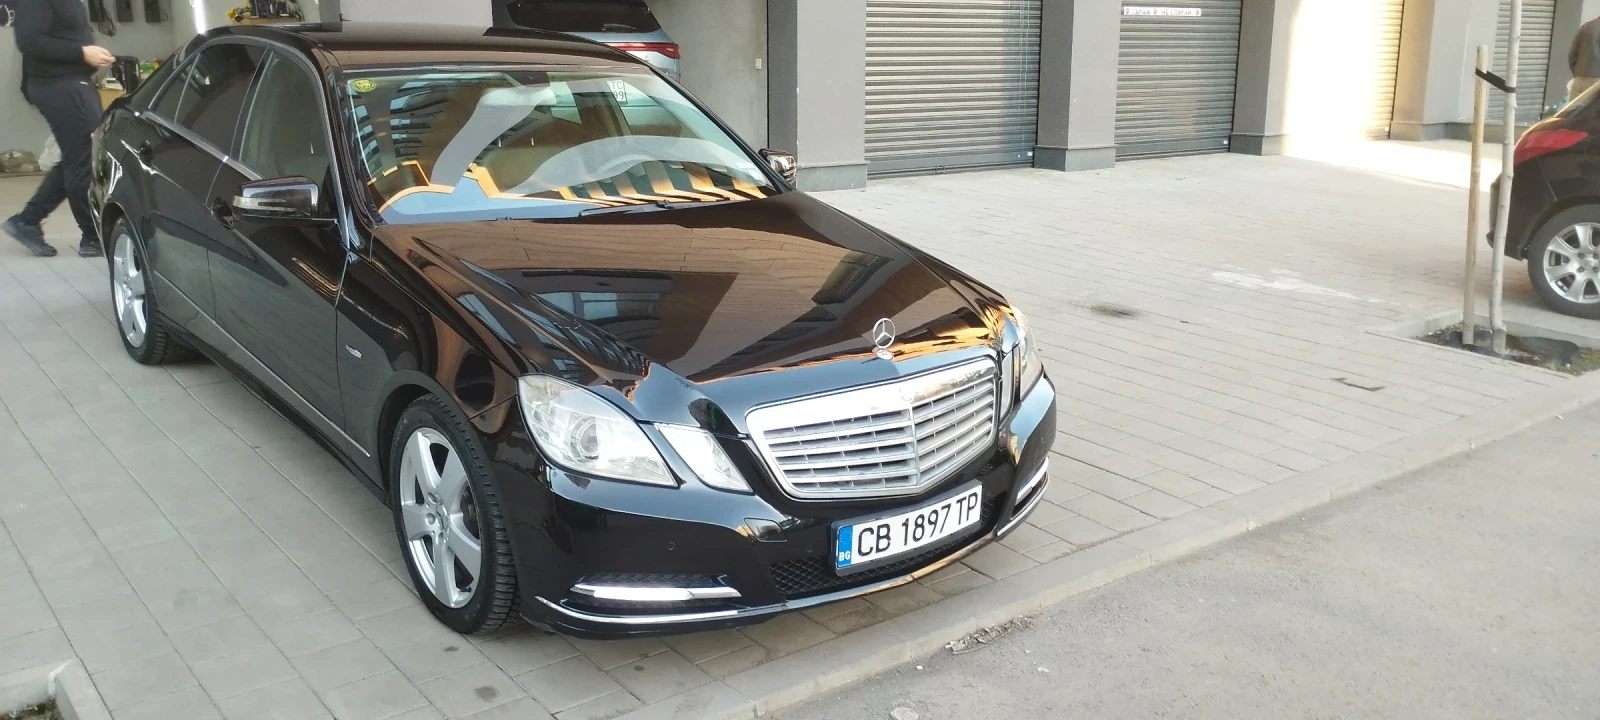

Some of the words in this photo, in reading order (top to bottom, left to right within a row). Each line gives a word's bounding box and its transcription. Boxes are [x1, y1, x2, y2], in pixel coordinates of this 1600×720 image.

[857, 523, 891, 557] CB
[901, 502, 952, 546] 1897
[956, 491, 978, 526] TP
[838, 551, 851, 562] BG
